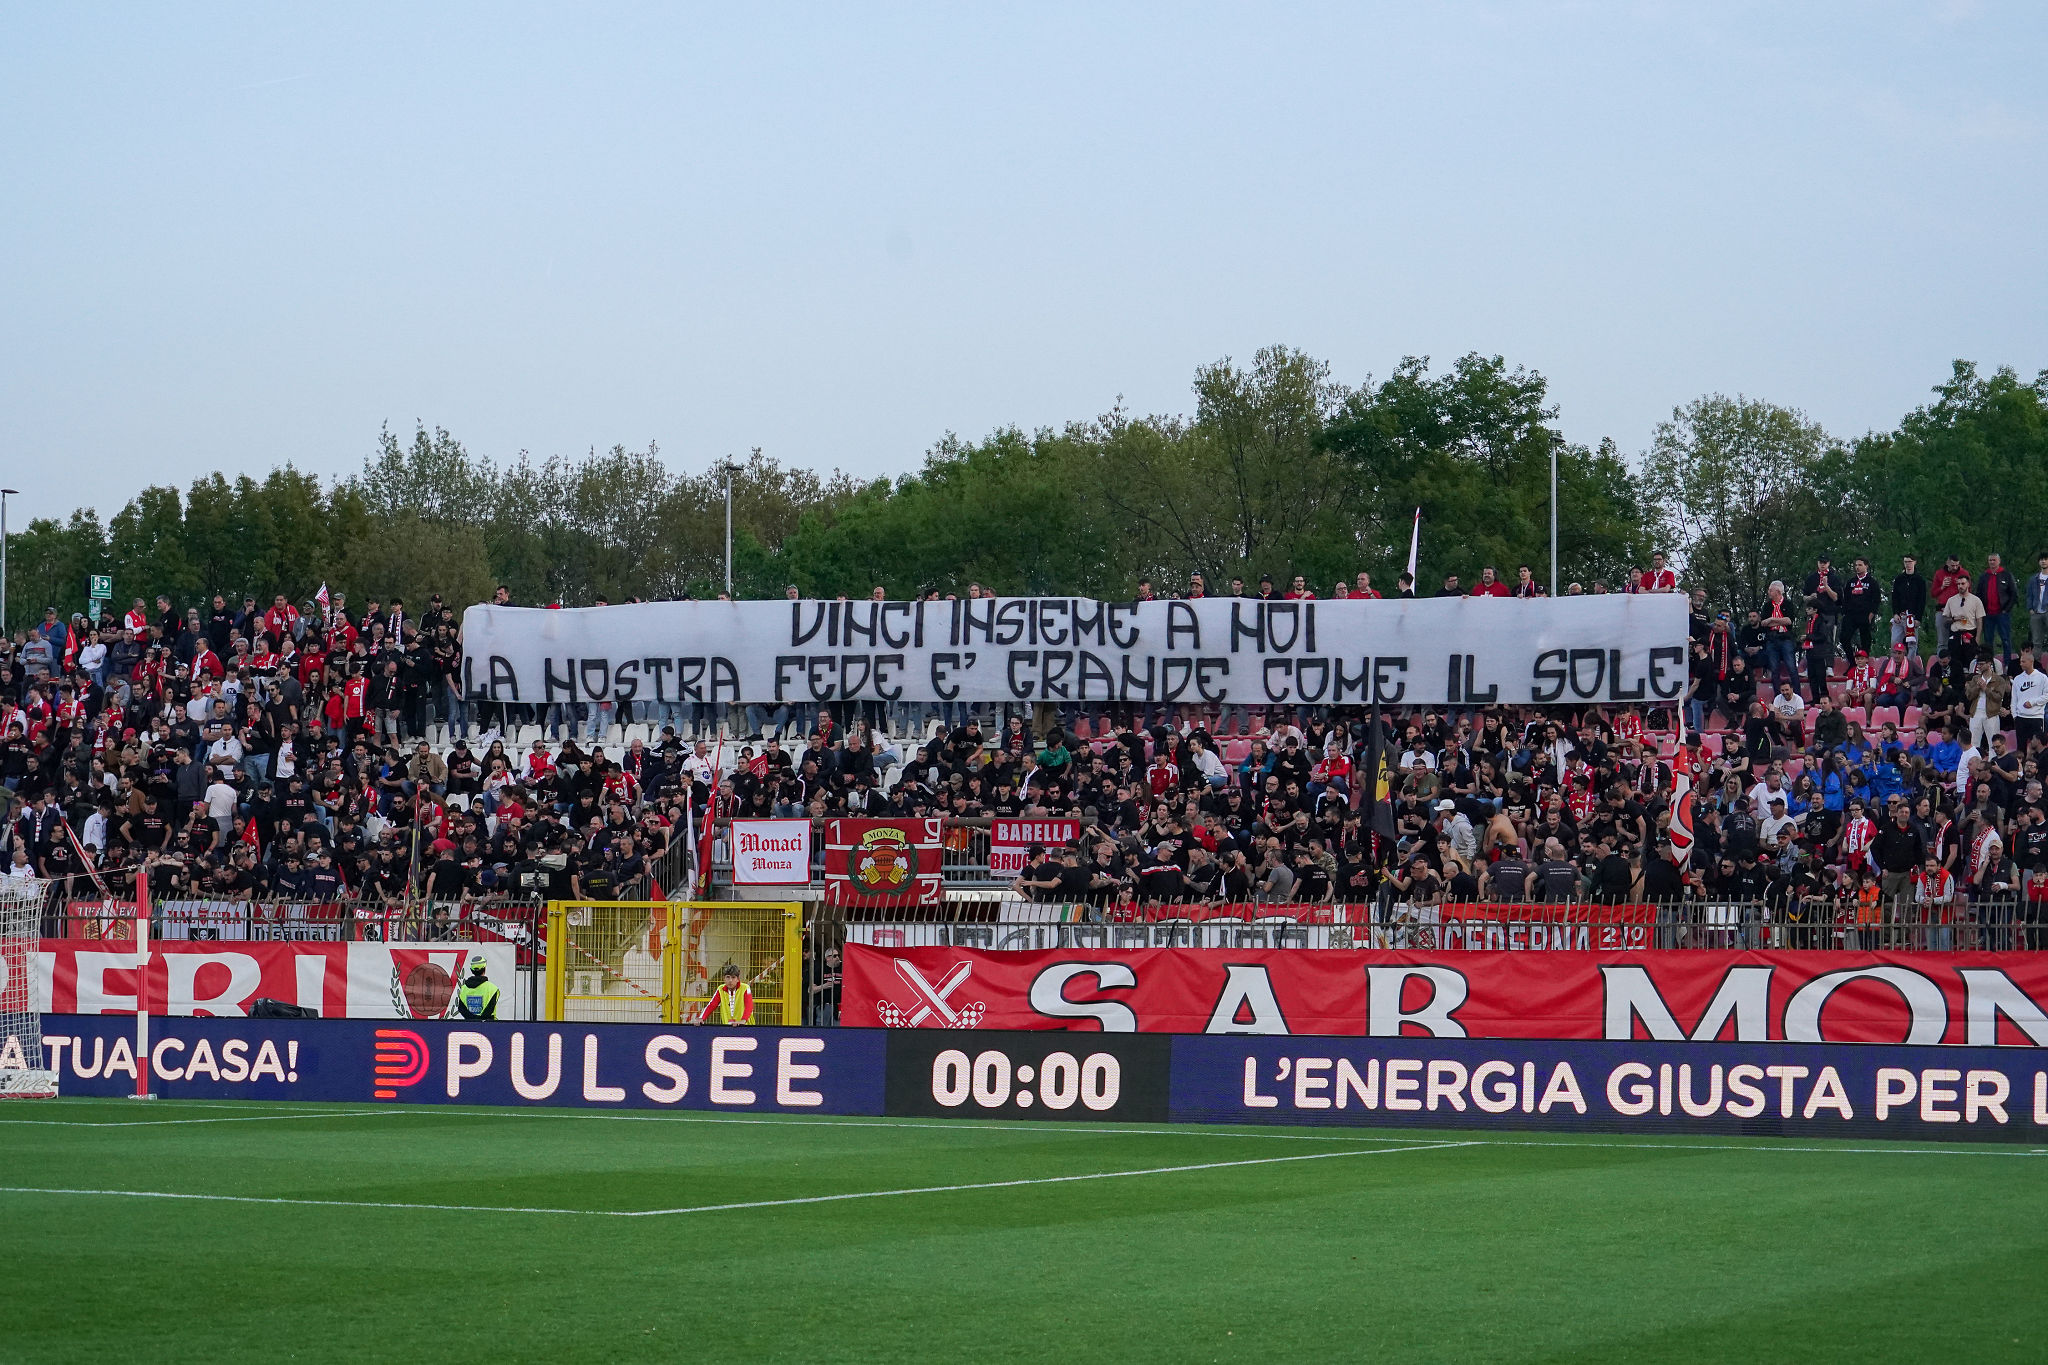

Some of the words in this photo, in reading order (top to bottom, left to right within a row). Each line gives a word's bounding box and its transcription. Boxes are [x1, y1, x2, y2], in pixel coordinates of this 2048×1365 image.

[792, 602, 924, 649] VINCI
[950, 600, 1140, 650] INSIEME
[1167, 602, 1200, 650] A
[1231, 602, 1315, 653] NOI
[463, 656, 519, 701] LA
[544, 656, 741, 702] NOSTRA
[774, 655, 904, 702] FEDE
[1007, 650, 1230, 702] GRANDE
[1262, 656, 1408, 703] COME
[1447, 654, 1498, 702] IL
[1532, 646, 1684, 701] SOLE
[740, 833, 802, 854] Monaci
[867, 830, 901, 840] MONZA
[997, 823, 1073, 842] BARELLA
[752, 858, 792, 872] Monza
[42, 1035, 138, 1079] TUA
[152, 1037, 298, 1082] CASA!
[445, 1031, 826, 1107] PULSEE
[931, 1049, 1122, 1112] 00:00
[1242, 1056, 1587, 1115] L'ENERGIA
[1605, 1061, 1855, 1121] GIUSTA
[1875, 1067, 2010, 1124] PER
